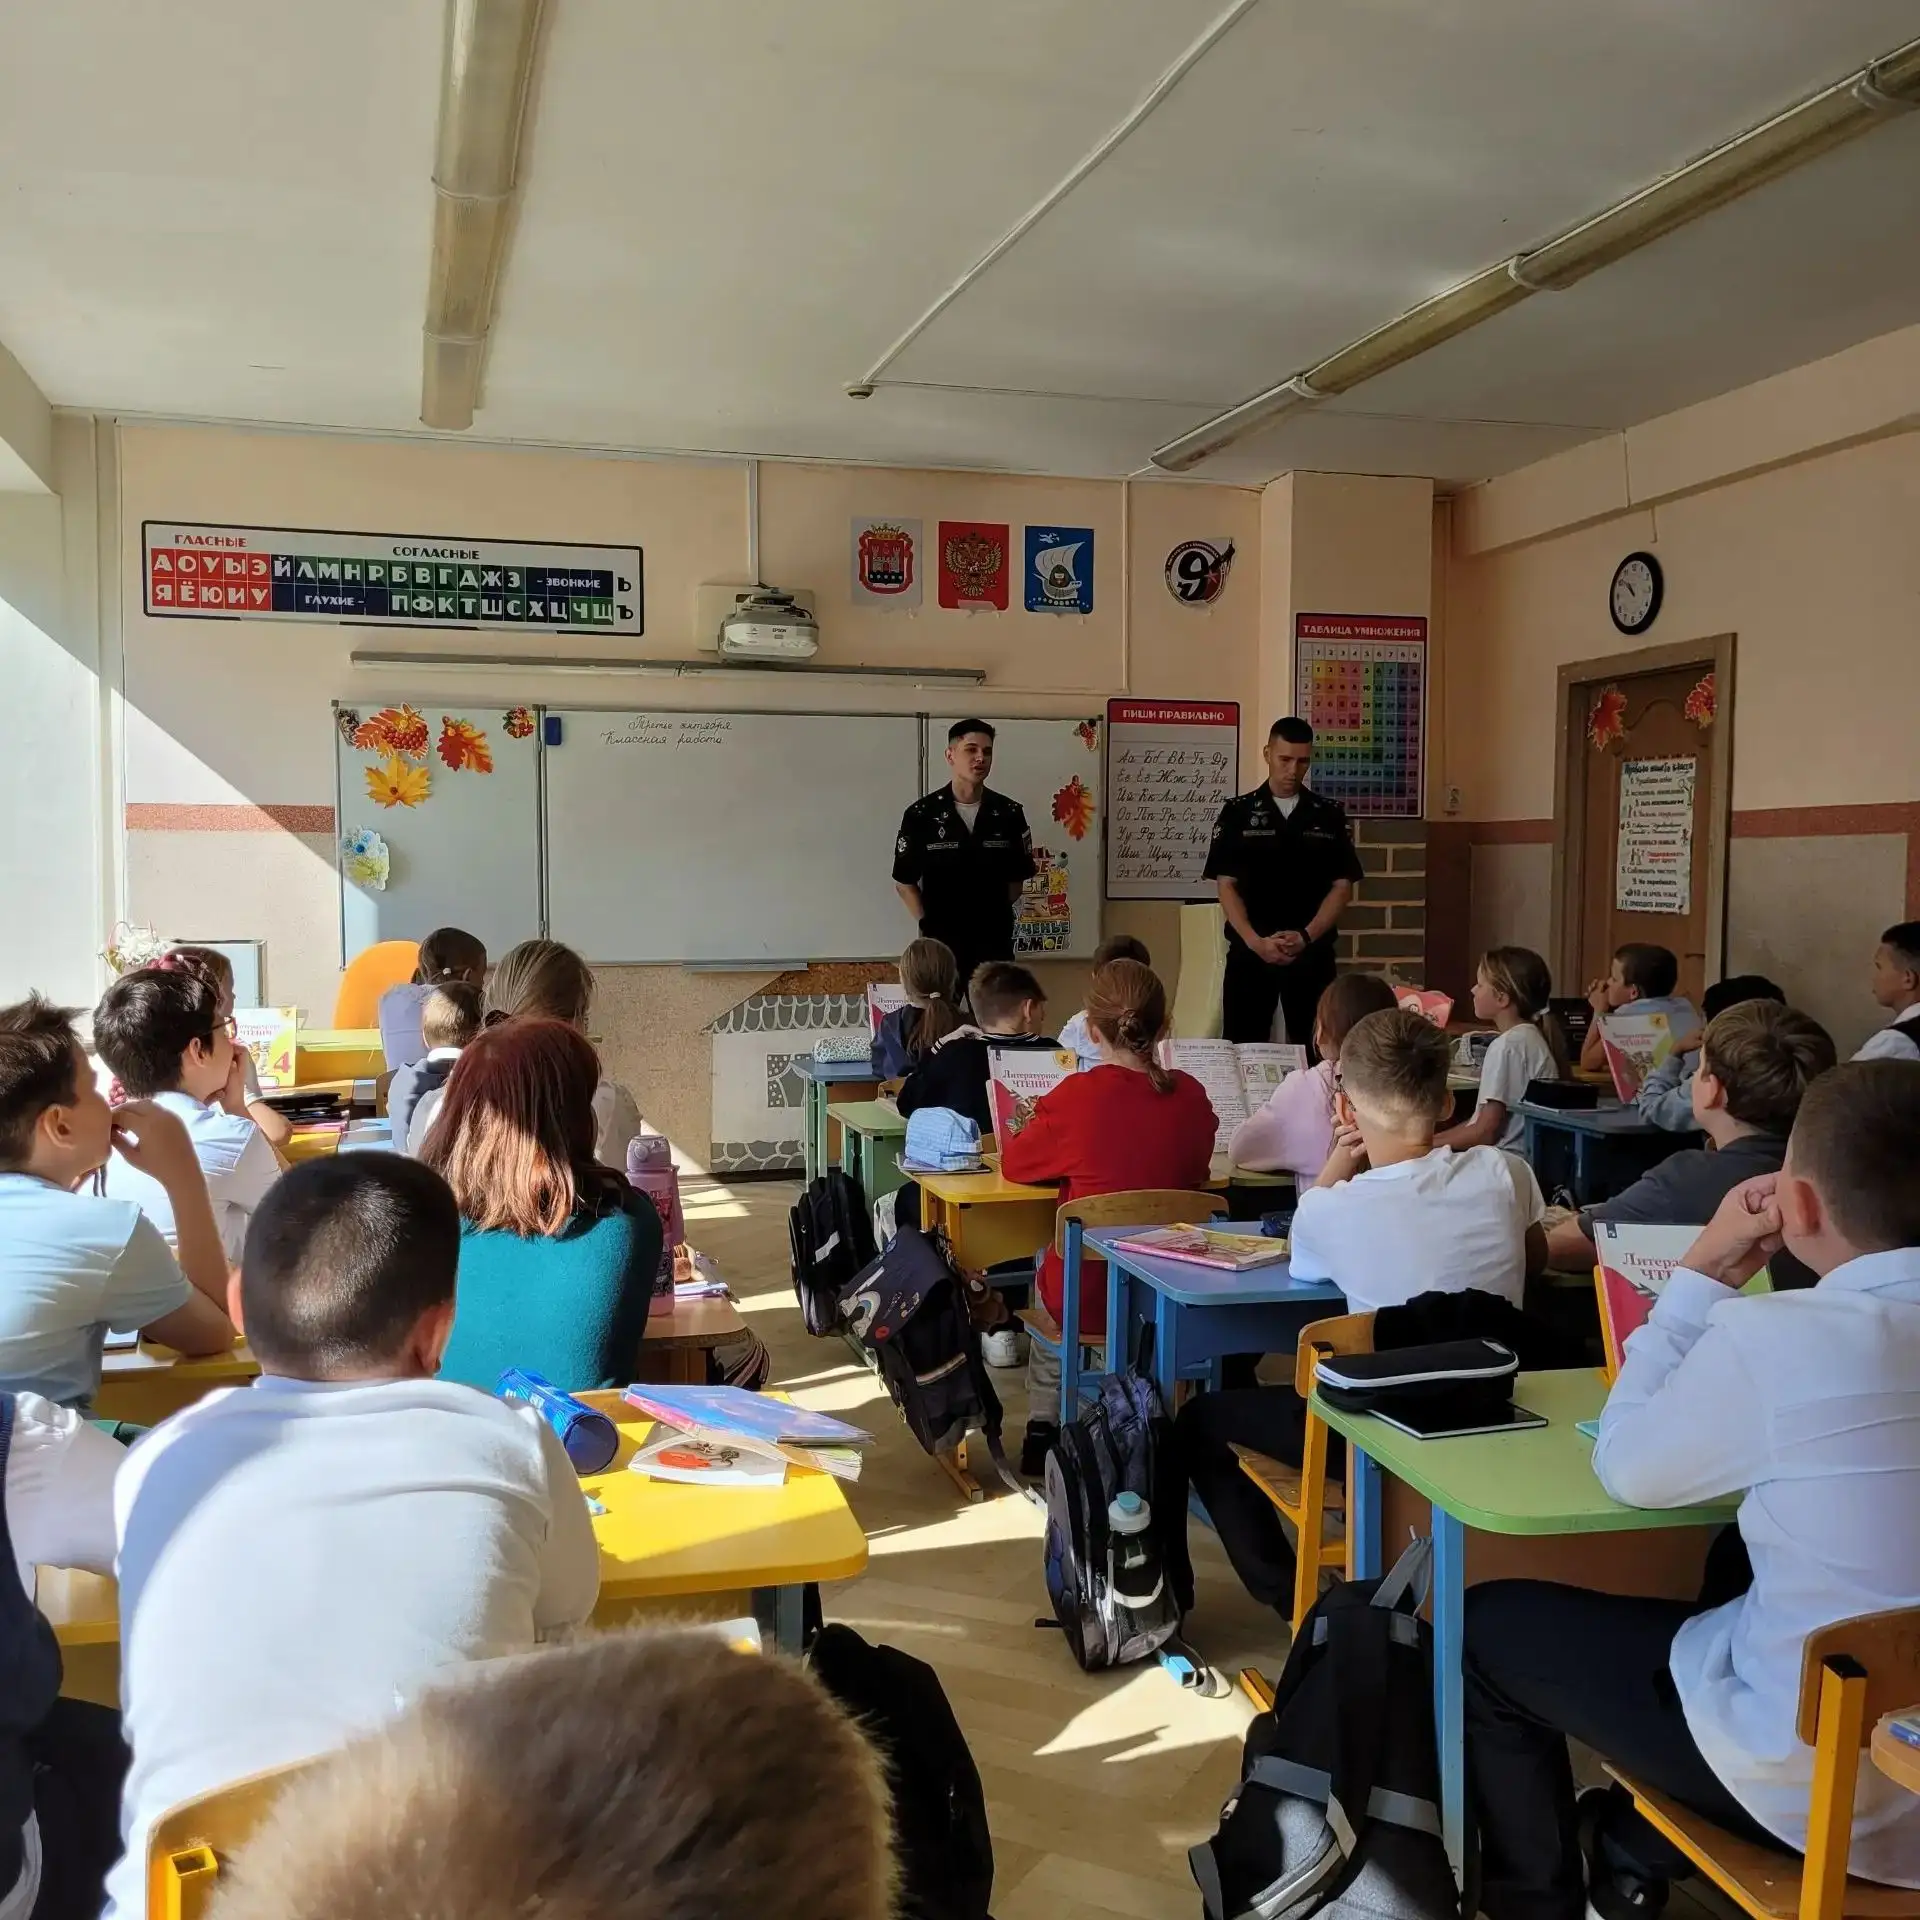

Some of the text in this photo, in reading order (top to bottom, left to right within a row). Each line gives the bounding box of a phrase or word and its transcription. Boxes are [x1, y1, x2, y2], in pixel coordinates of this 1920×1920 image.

[174, 534, 248, 548] ГЛАСНЫЕ
[392, 546, 481, 560] СОГЛАСНЫЕ
[545, 577, 601, 588] ЗВОНКИЕ
[304, 594, 355, 606] ГЛУХИЕ
[1303, 625, 1421, 636] ТАБЛИЦА УМНОЖЕНИЯ
[1122, 710, 1224, 720] ПИШИ ПРАВИЛЬНО
[600, 728, 723, 751] Классная работа
[274, 1051, 292, 1074] 4
[1002, 1070, 1060, 1080] Литературное
[1012, 1080, 1052, 1088] ЧТЕНИЕ
